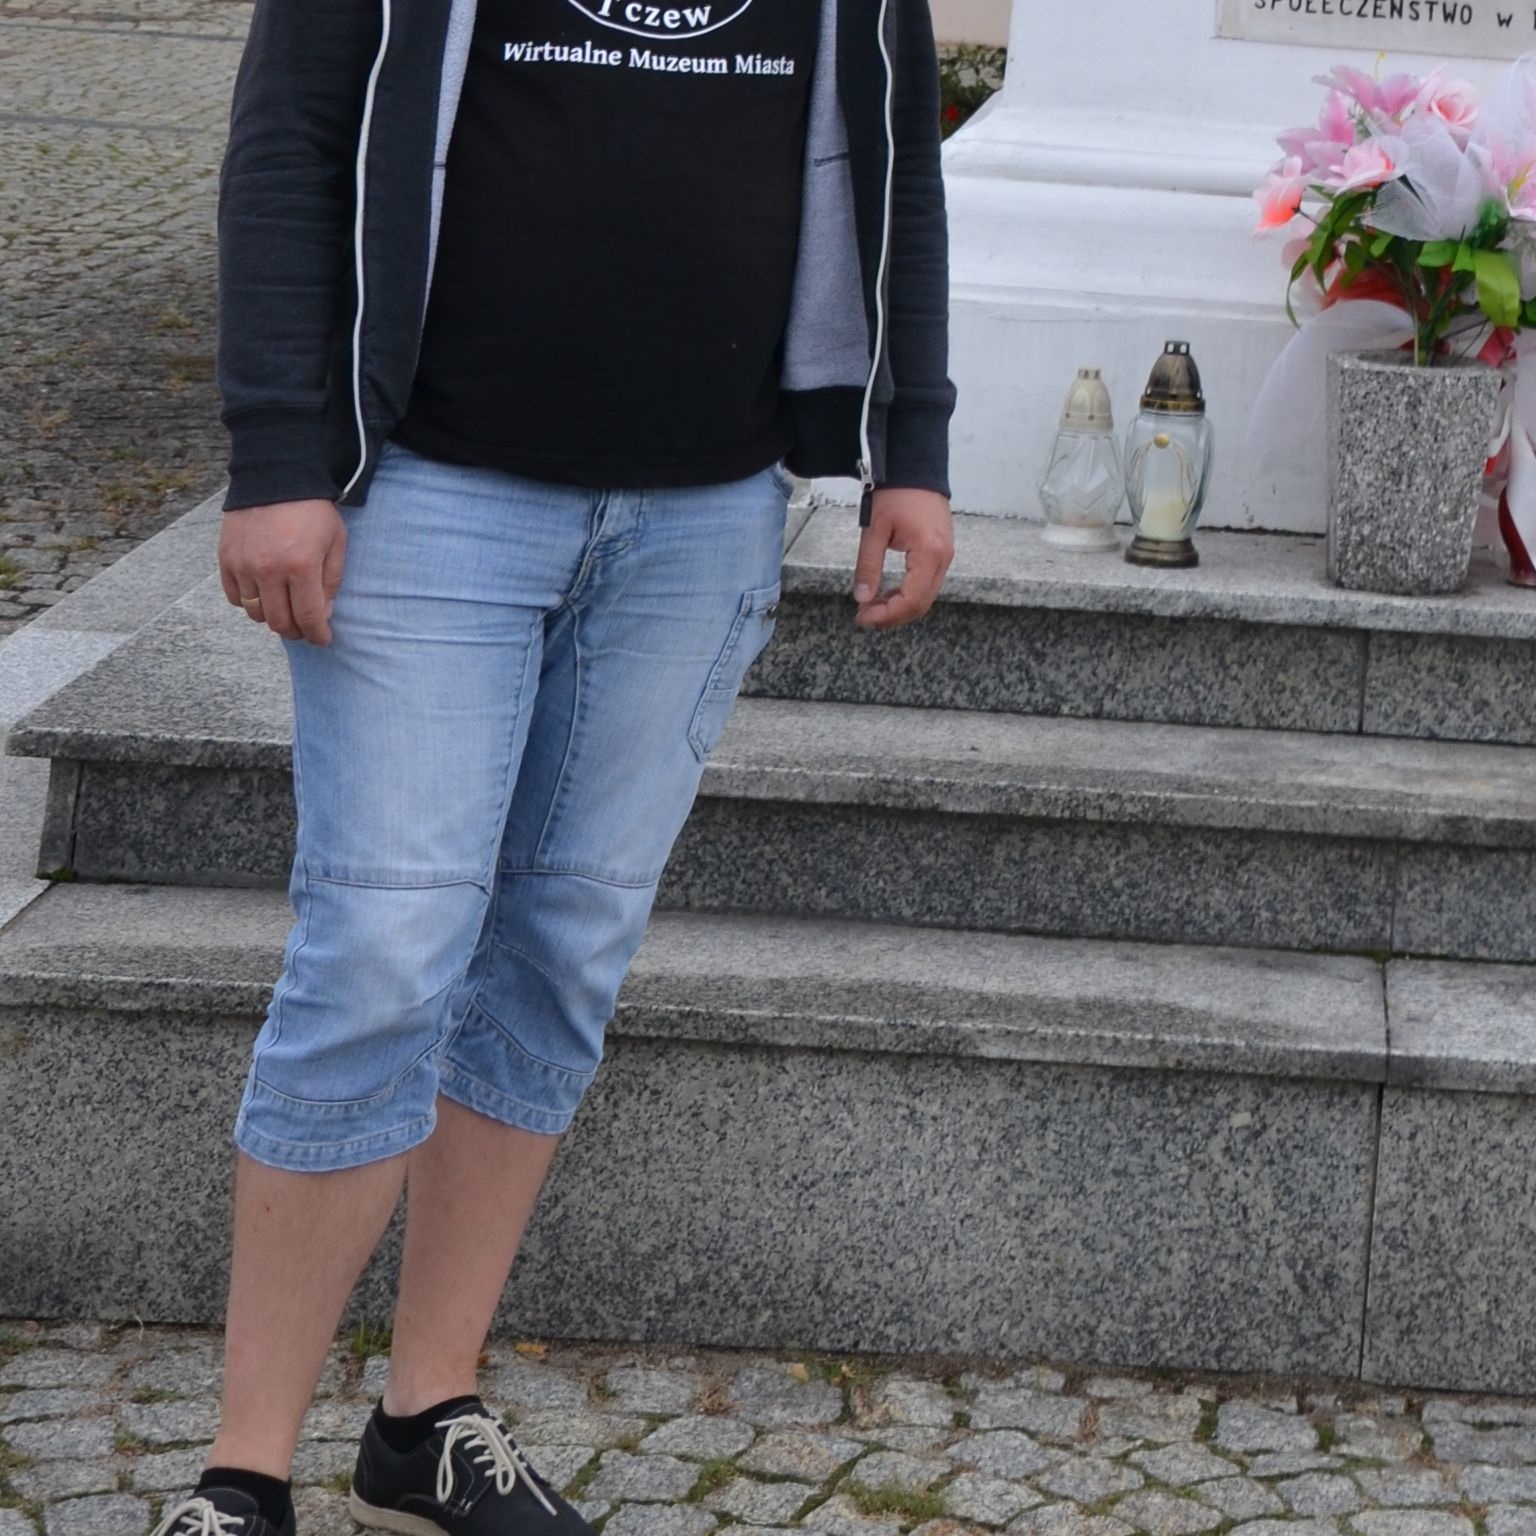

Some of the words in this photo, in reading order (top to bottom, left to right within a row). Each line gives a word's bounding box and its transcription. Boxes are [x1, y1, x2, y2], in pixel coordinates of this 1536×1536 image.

[503, 40, 623, 66] Wirtualne
[628, 47, 729, 75] Muzeum
[734, 54, 796, 76] Miasta
